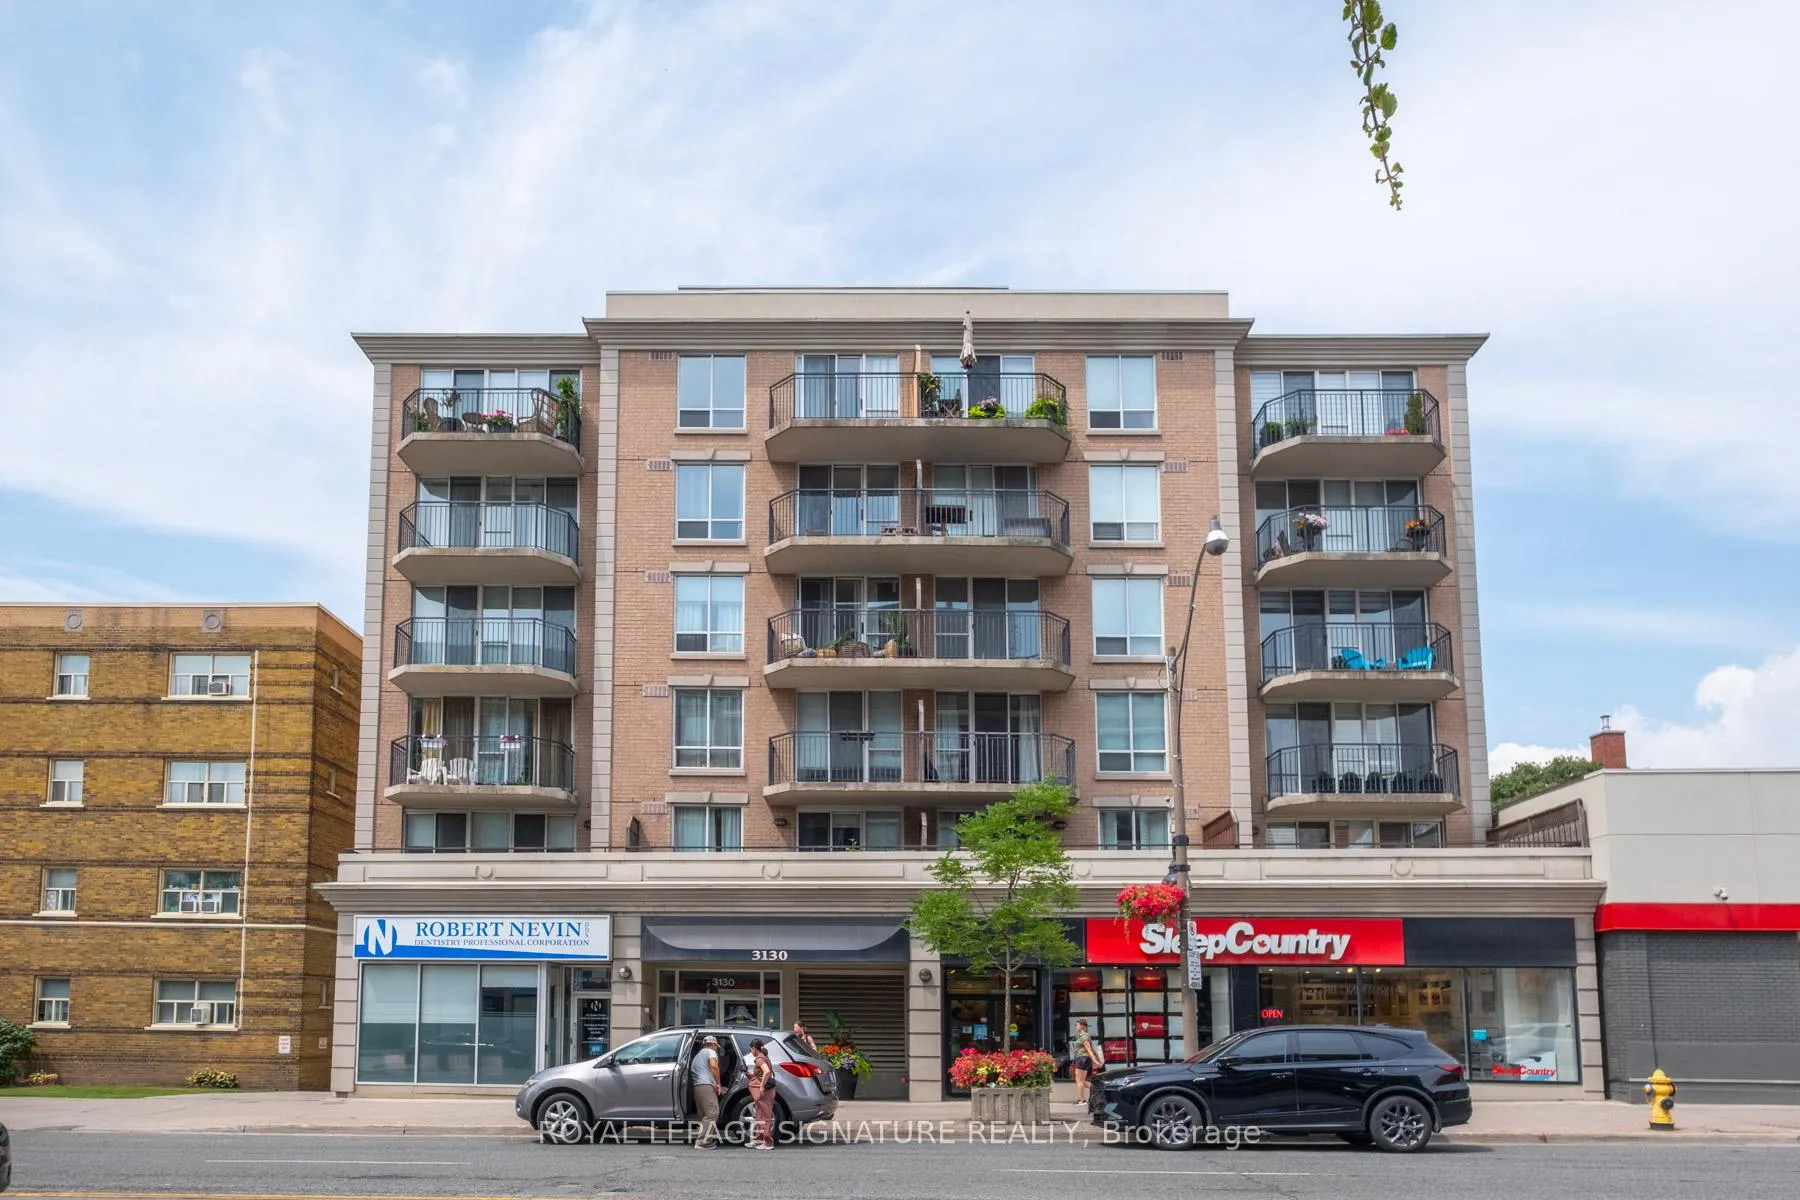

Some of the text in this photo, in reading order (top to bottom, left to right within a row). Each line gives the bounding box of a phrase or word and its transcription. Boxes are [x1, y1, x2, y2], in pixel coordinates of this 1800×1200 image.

[415, 921, 582, 937] ROBERT NEVIN
[414, 939, 590, 947] DENTISTRY PROFESSIONAL CORPORATION
[751, 950, 788, 961] 3130
[711, 977, 735, 987] 3130
[1261, 1009, 1283, 1019] OPEN
